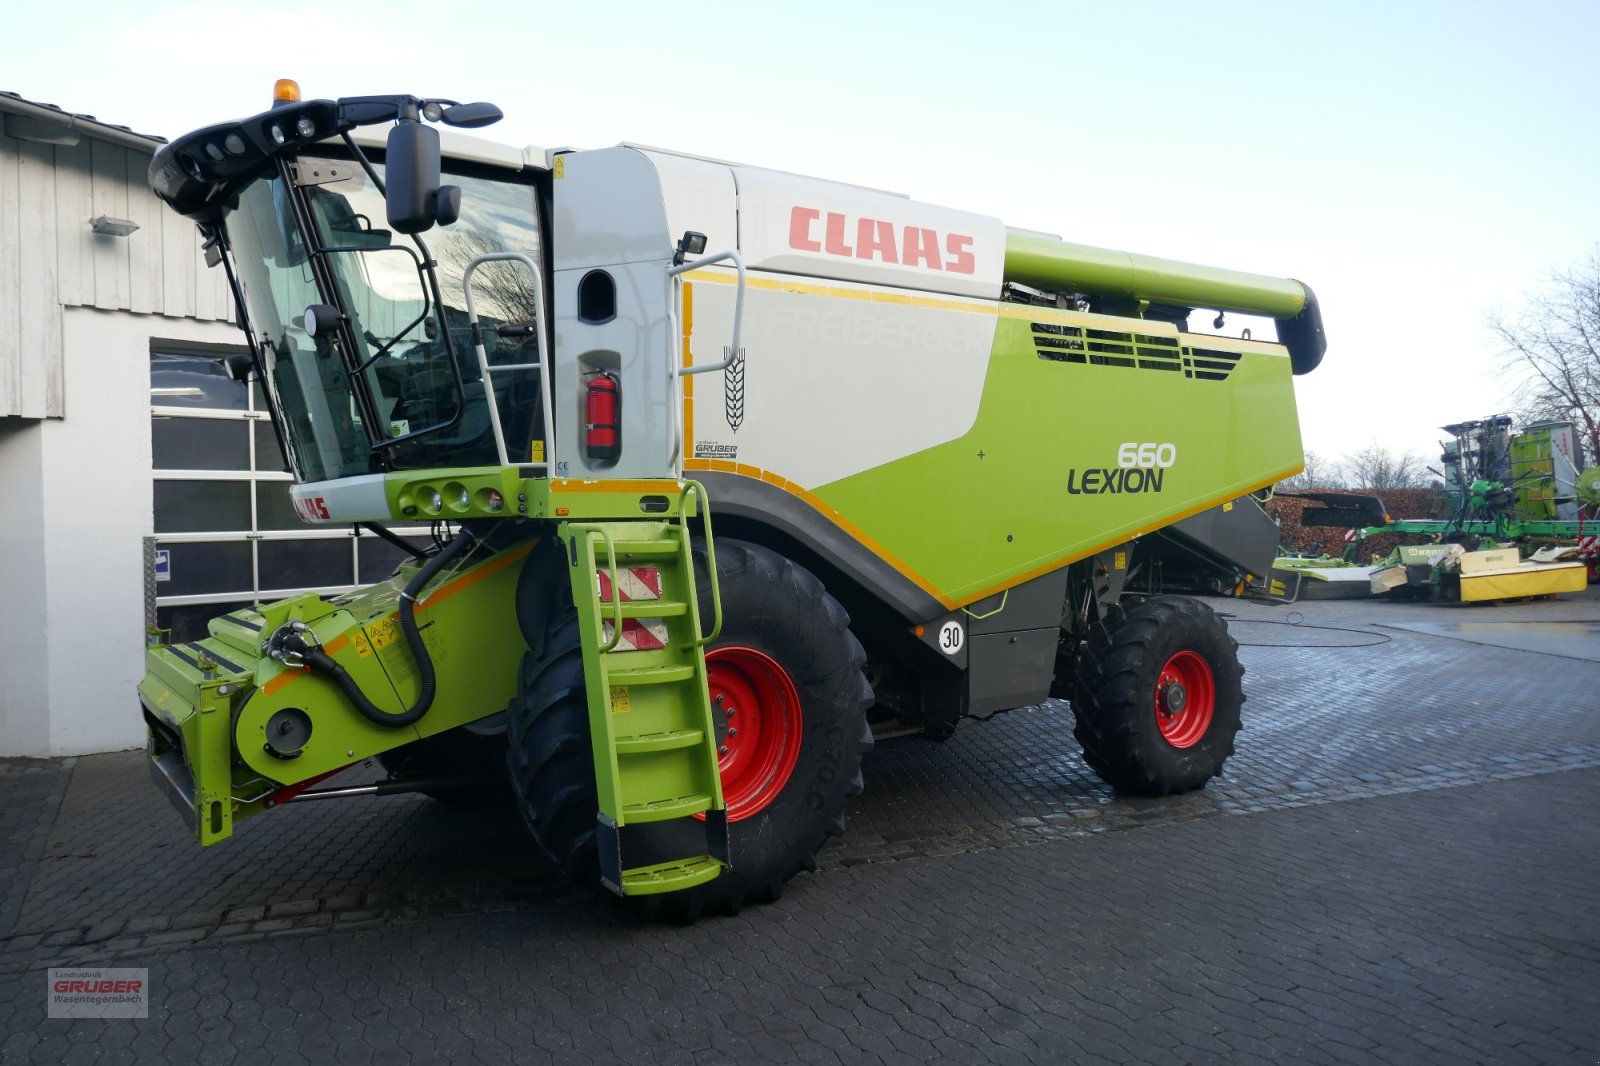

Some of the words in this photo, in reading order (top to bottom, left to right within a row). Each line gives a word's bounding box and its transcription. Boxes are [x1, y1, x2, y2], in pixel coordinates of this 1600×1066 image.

[788, 205, 975, 275] CLAAS
[695, 444, 738, 453] GRUBER
[1117, 442, 1177, 468] 660
[1067, 468, 1164, 494] LEXION
[943, 627, 960, 648] 30
